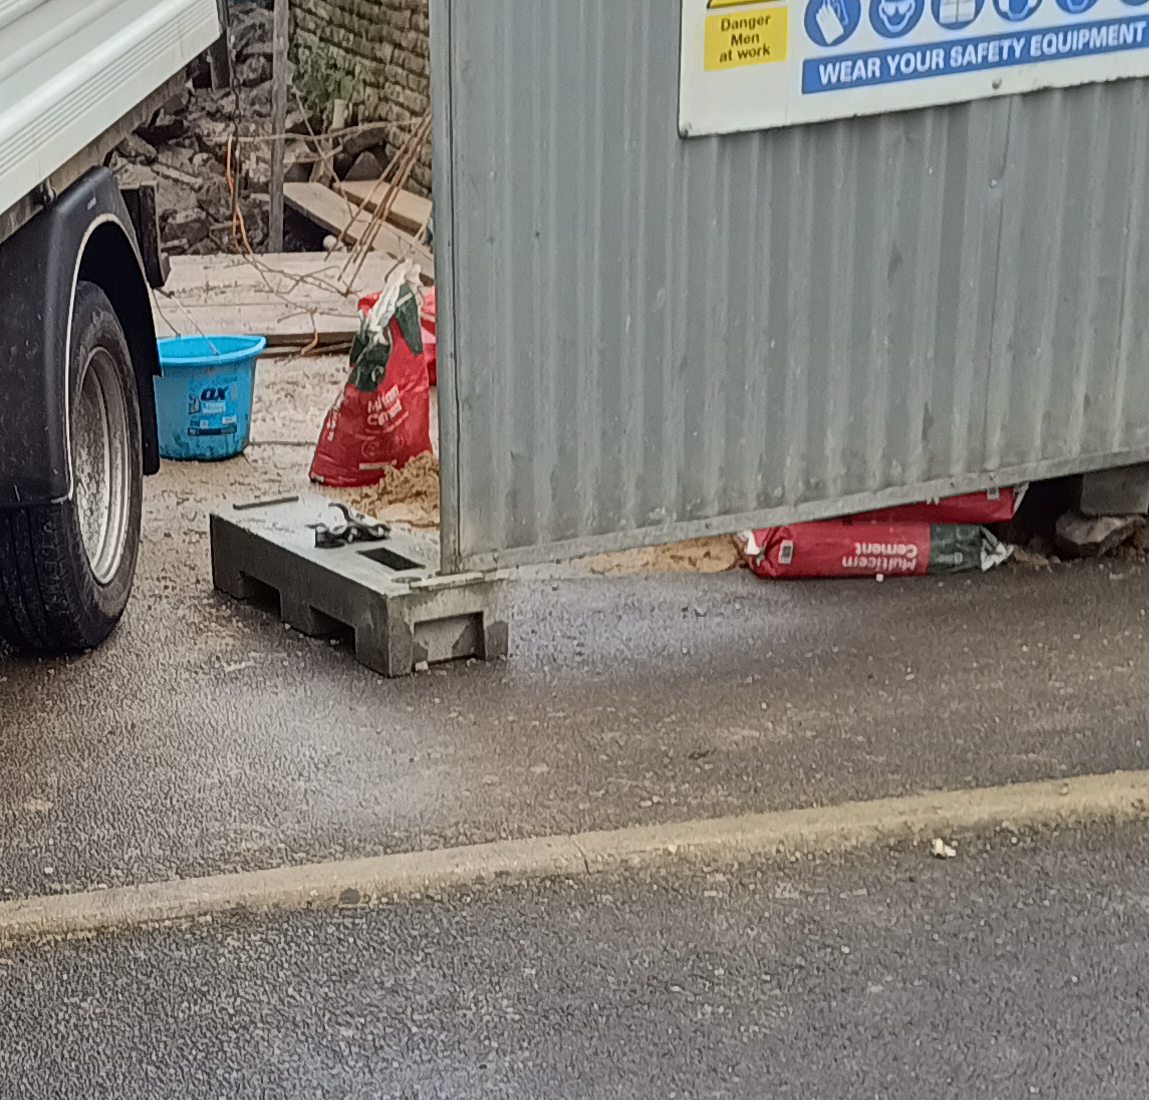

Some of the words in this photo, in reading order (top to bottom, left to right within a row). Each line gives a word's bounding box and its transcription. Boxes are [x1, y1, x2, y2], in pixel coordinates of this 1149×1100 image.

[721, 14, 771, 32] Danger
[731, 33, 760, 47] Men
[719, 49, 732, 63] at
[737, 43, 771, 60] work
[818, 57, 881, 85] WEAR
[887, 49, 945, 77] YOUR
[950, 37, 1026, 70] SAFETY
[1030, 21, 1147, 57] EQUIPMENT
[855, 542, 918, 558] Cement
